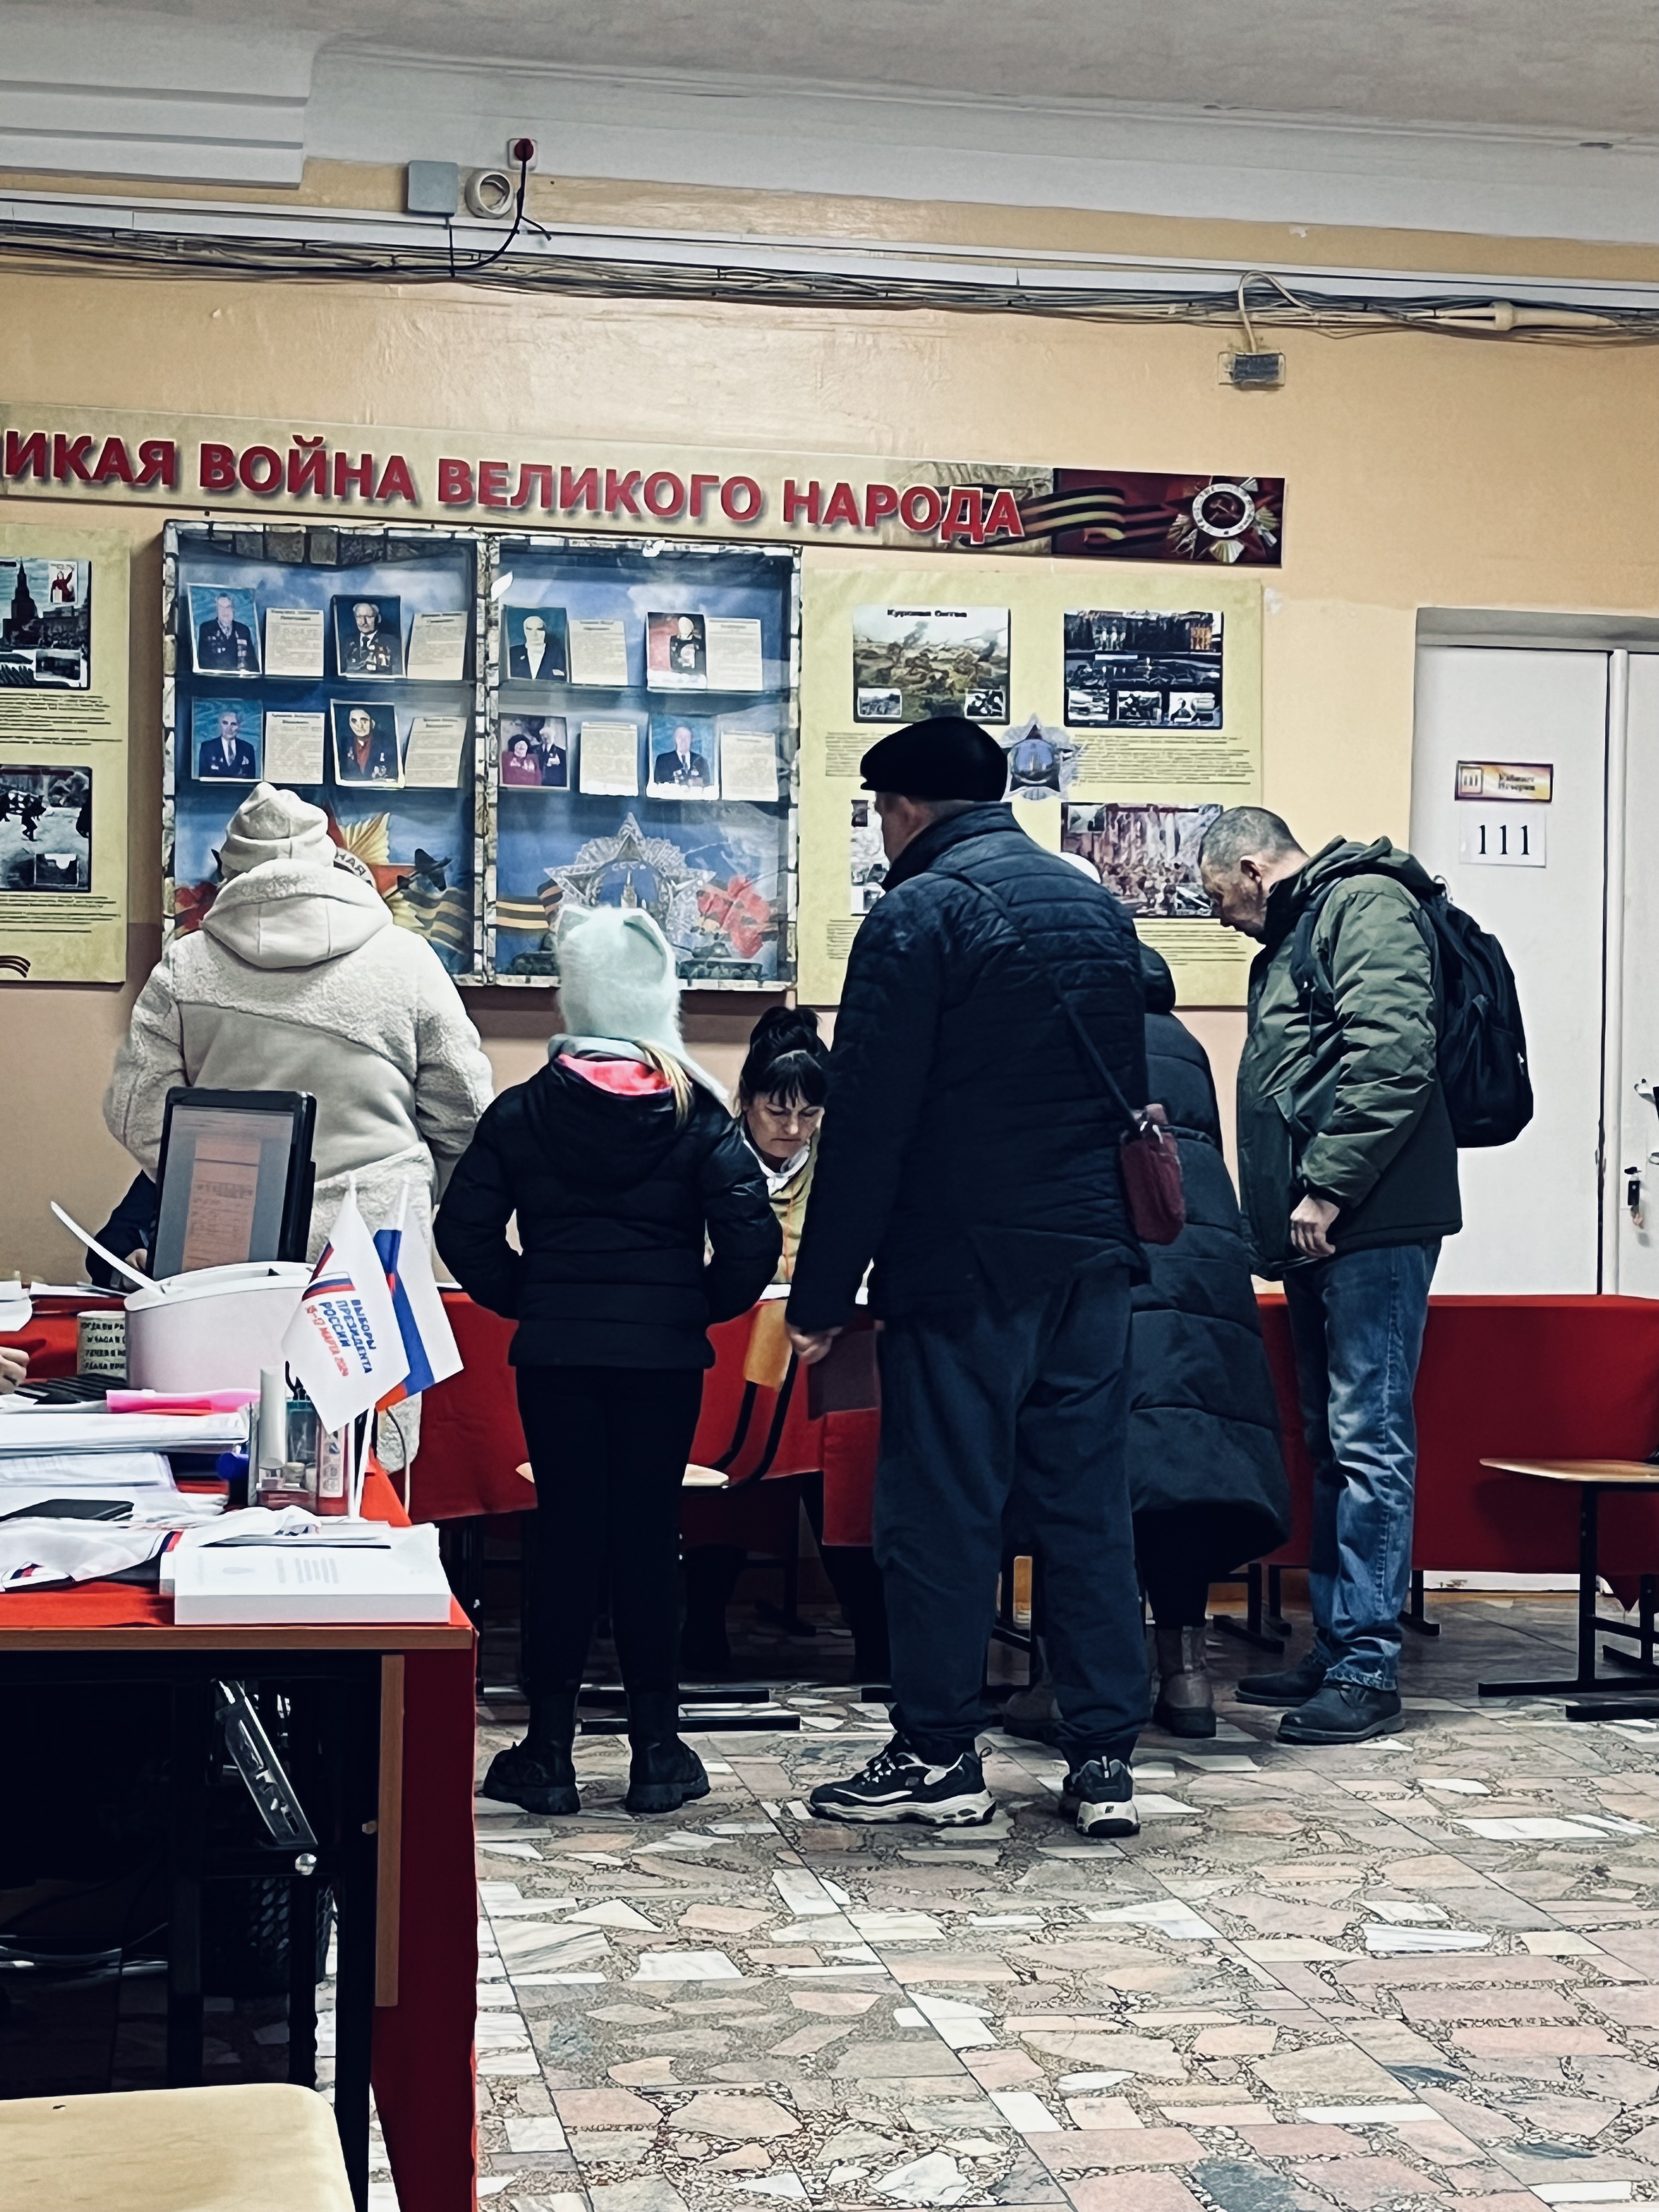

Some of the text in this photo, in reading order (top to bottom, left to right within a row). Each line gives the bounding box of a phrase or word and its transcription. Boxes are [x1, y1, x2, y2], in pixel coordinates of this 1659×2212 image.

[199, 435, 415, 500] ВОЙНА
[438, 458, 762, 521] ВЕЛИКОГО
[783, 479, 1024, 543] НАРОДА
[1478, 824, 1530, 855] 111
[318, 1301, 351, 1347] РОССИИ
[335, 1300, 373, 1374] ПРЕЗИДЕНТА
[350, 1299, 377, 1350] ВЫБОРЫ
